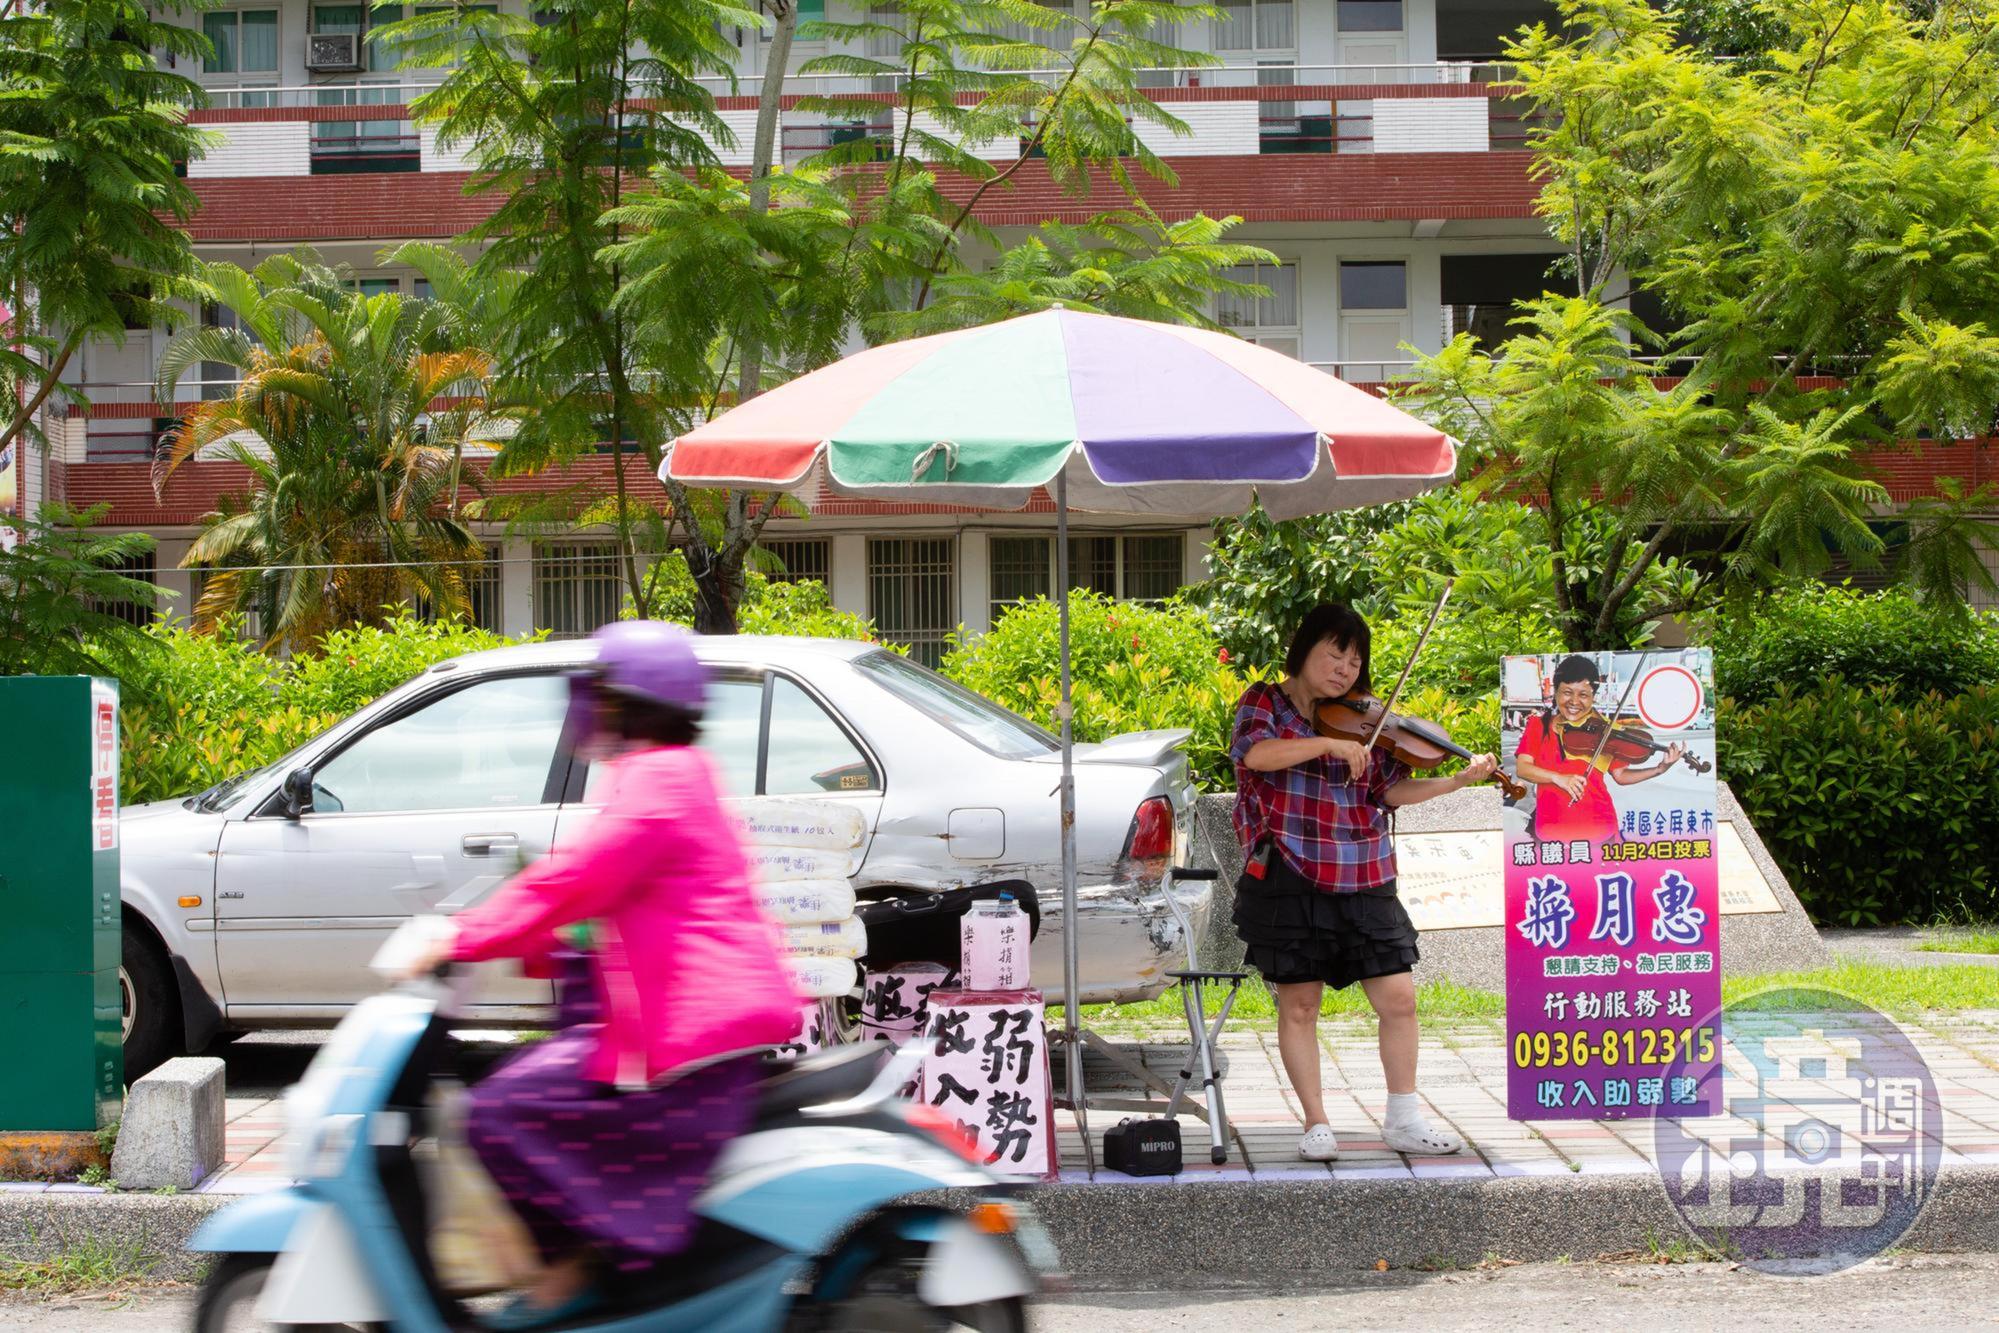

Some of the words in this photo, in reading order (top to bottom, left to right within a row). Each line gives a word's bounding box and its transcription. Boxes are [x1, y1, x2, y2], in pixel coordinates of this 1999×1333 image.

[1620, 809, 1713, 841] 選區全屏東市
[1513, 840, 1592, 866] 縣議員
[1602, 839, 1711, 861] 11月24日投票
[1516, 869, 1709, 948] 蔣月惠
[1543, 951, 1714, 977] 懇請支持、為民服務
[1543, 988, 1693, 1020] 行動服務站
[1514, 1027, 1716, 1068] 0936-812315
[1537, 1076, 1698, 1107] 收入助弱勢
[1141, 1140, 1175, 1153] MIPRO
